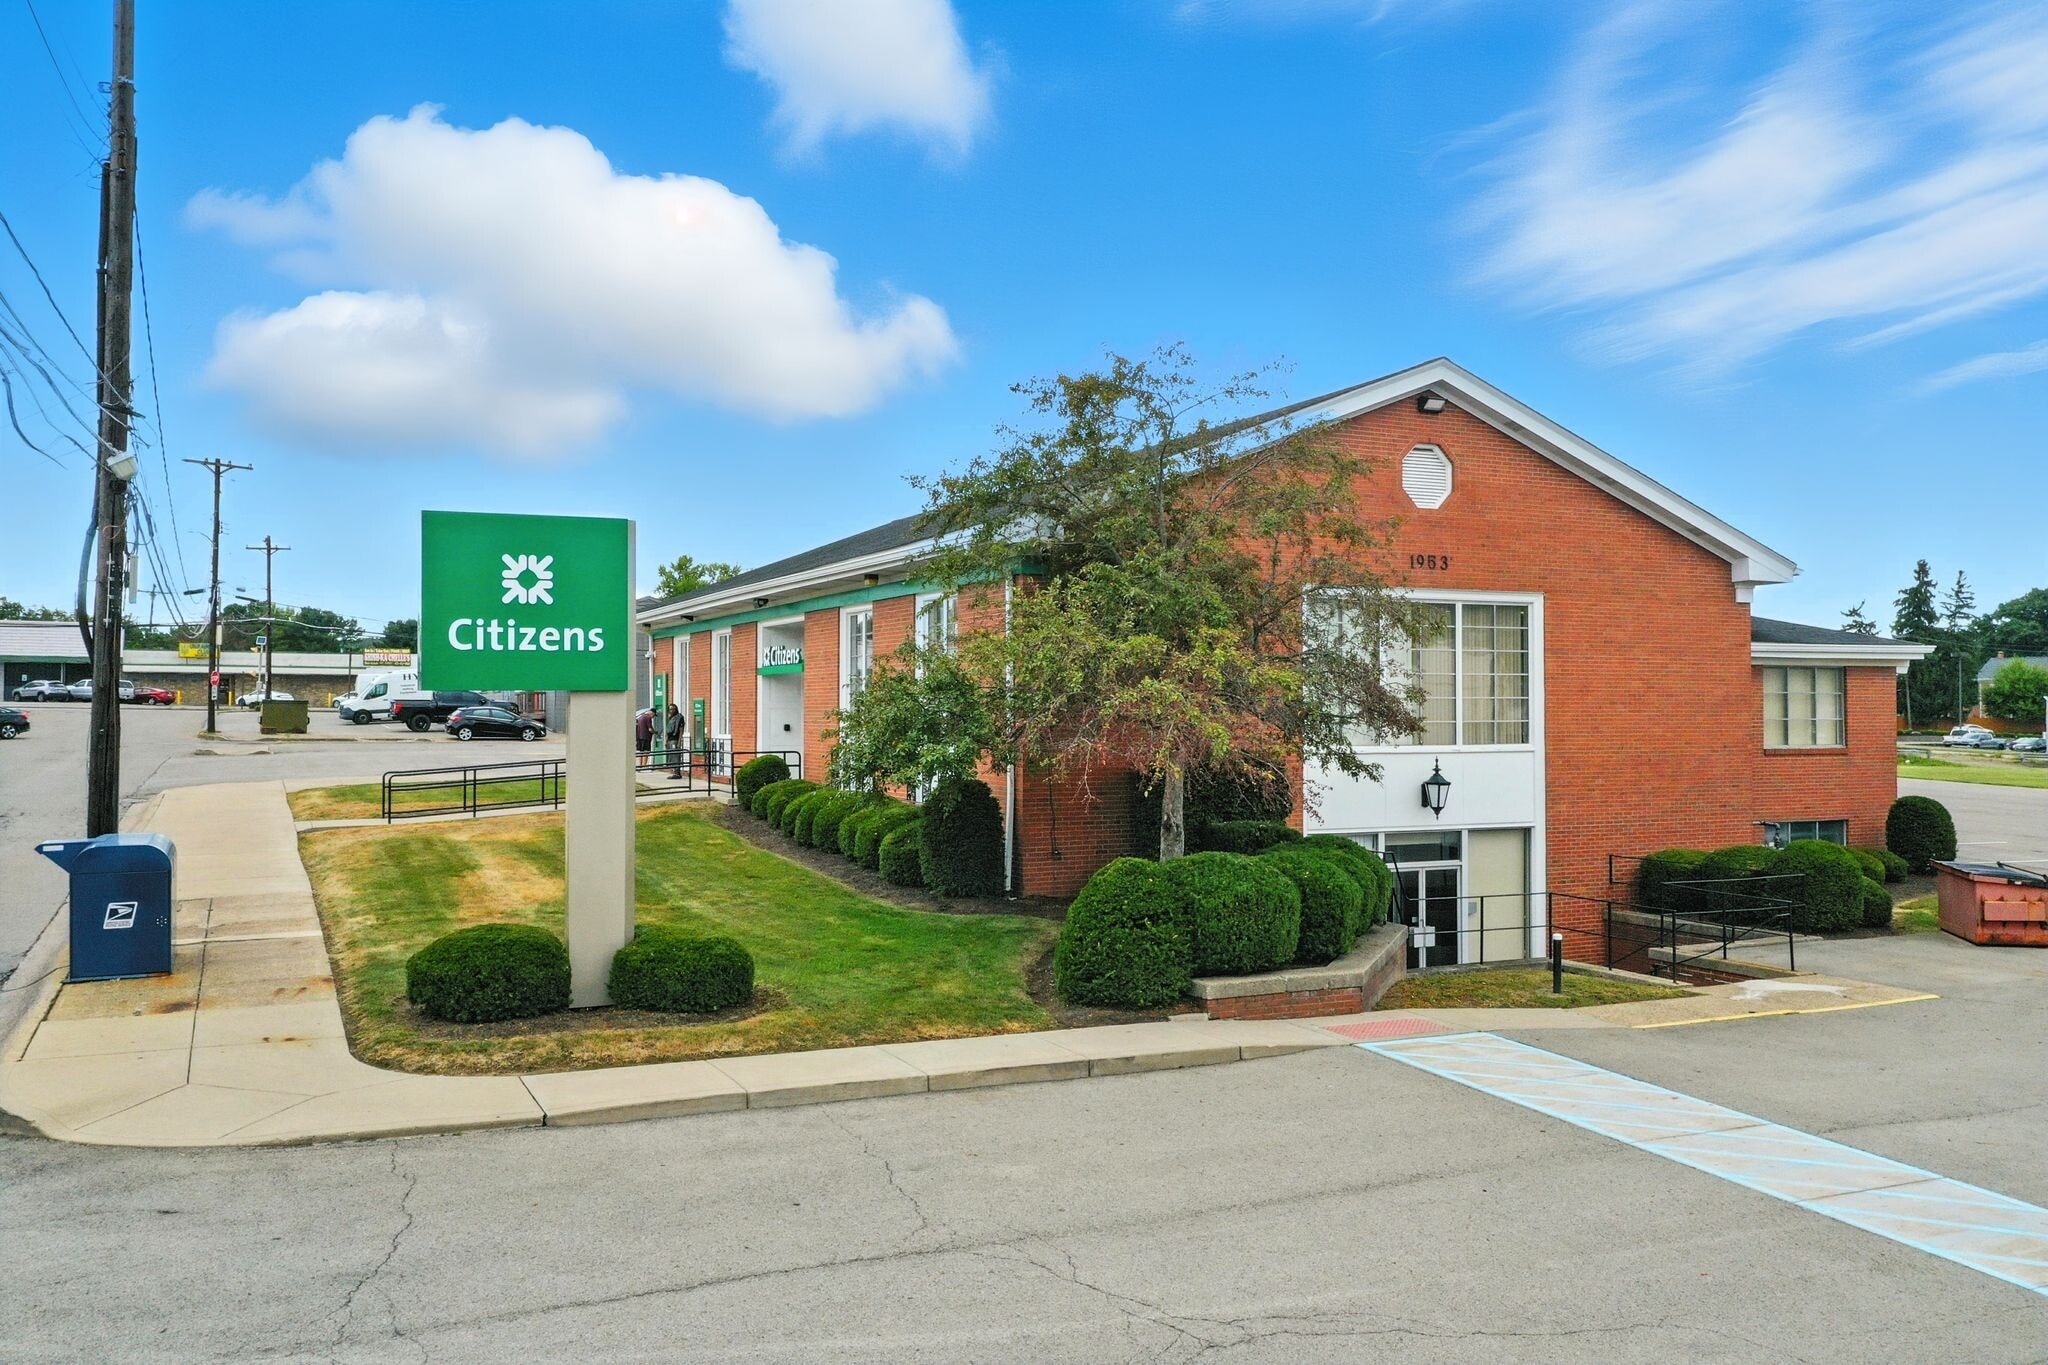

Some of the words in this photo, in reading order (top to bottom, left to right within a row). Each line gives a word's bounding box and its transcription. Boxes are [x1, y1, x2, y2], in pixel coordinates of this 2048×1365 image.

[1410, 554, 1448, 570] 1953
[448, 618, 604, 652] Citizens
[770, 645, 800, 666] Citizens
